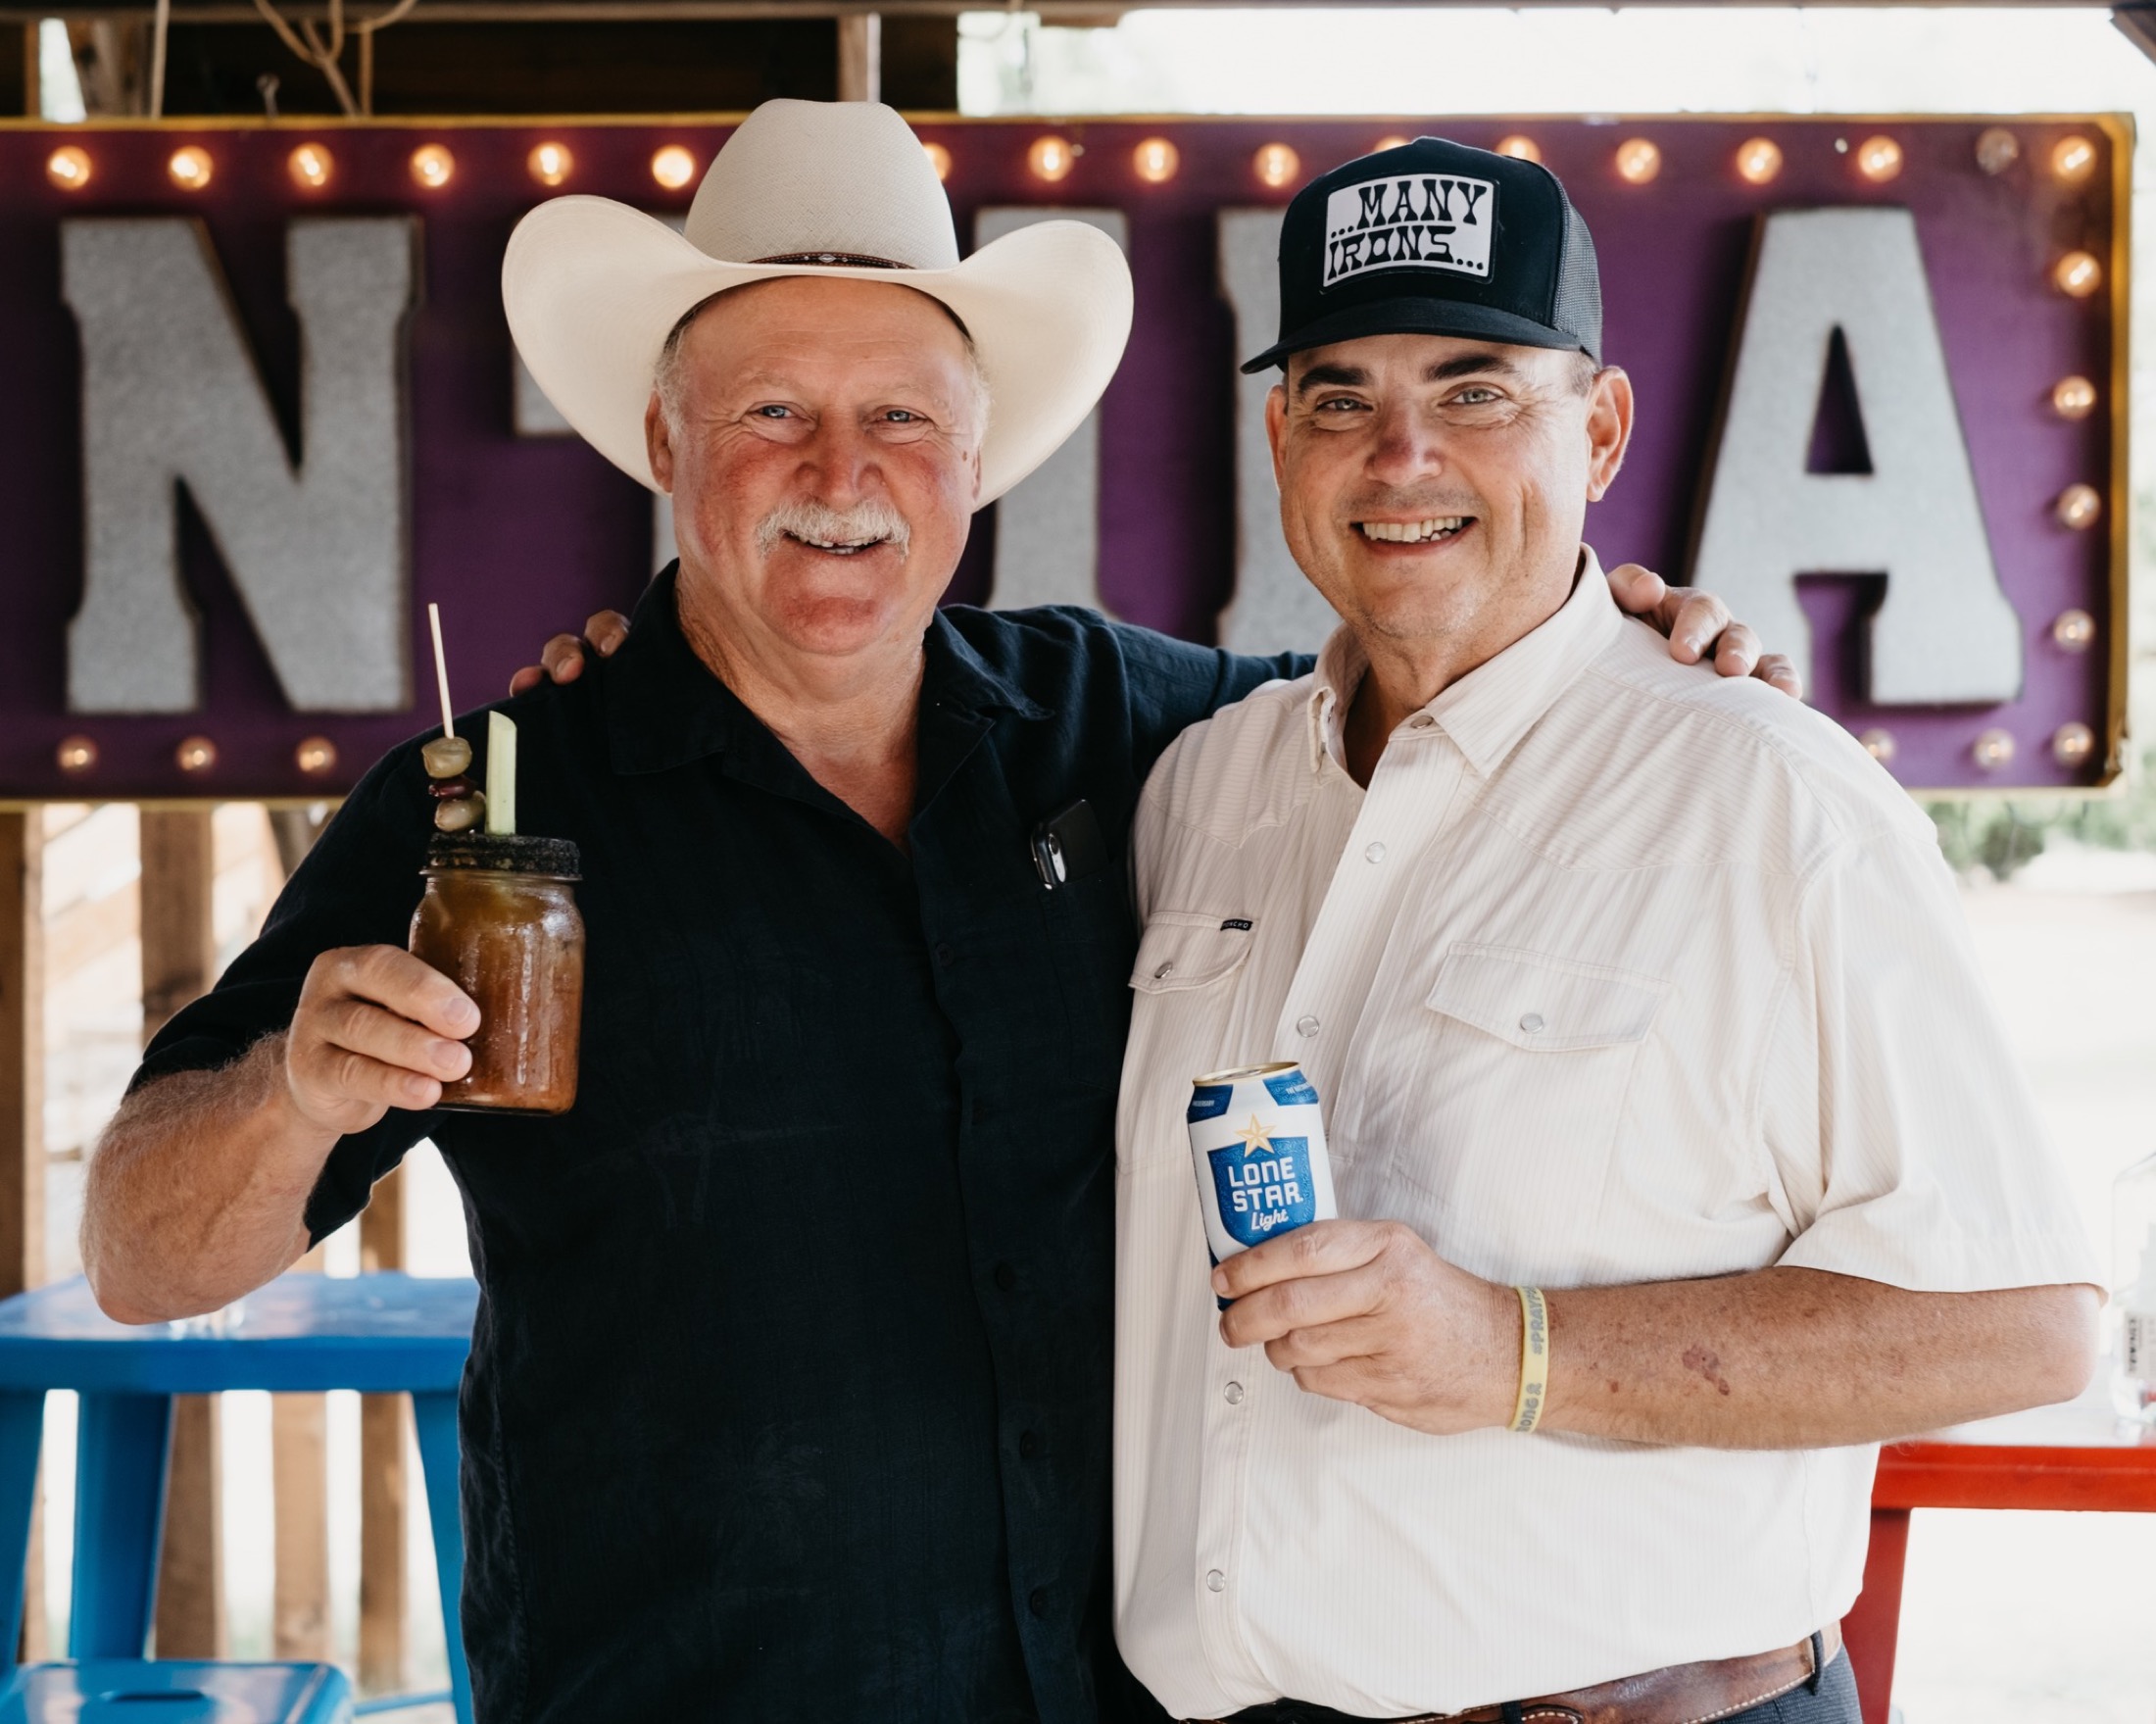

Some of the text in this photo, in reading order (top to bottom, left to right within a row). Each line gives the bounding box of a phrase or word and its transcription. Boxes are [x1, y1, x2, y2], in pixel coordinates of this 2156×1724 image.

[1228, 1156, 1296, 1188] LONE
[1232, 1181, 1301, 1212] STAR
[1250, 1208, 1289, 1232] Light
